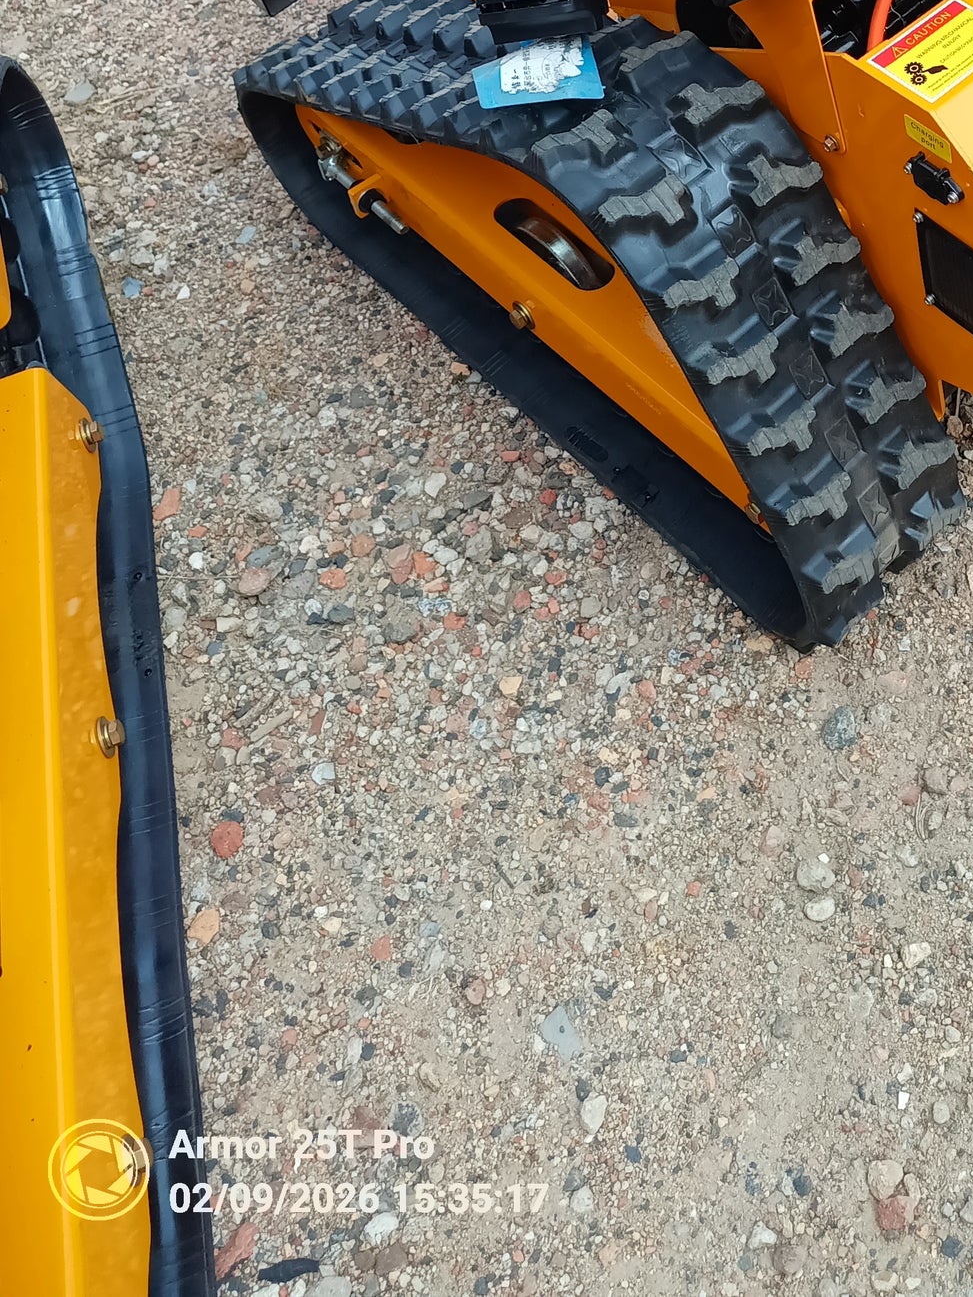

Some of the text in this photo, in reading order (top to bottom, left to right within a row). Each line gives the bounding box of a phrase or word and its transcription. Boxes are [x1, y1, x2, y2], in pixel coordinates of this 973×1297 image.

[905, 11, 953, 46] CAUTION
[910, 121, 944, 149] Charging
[920, 135, 937, 151] port
